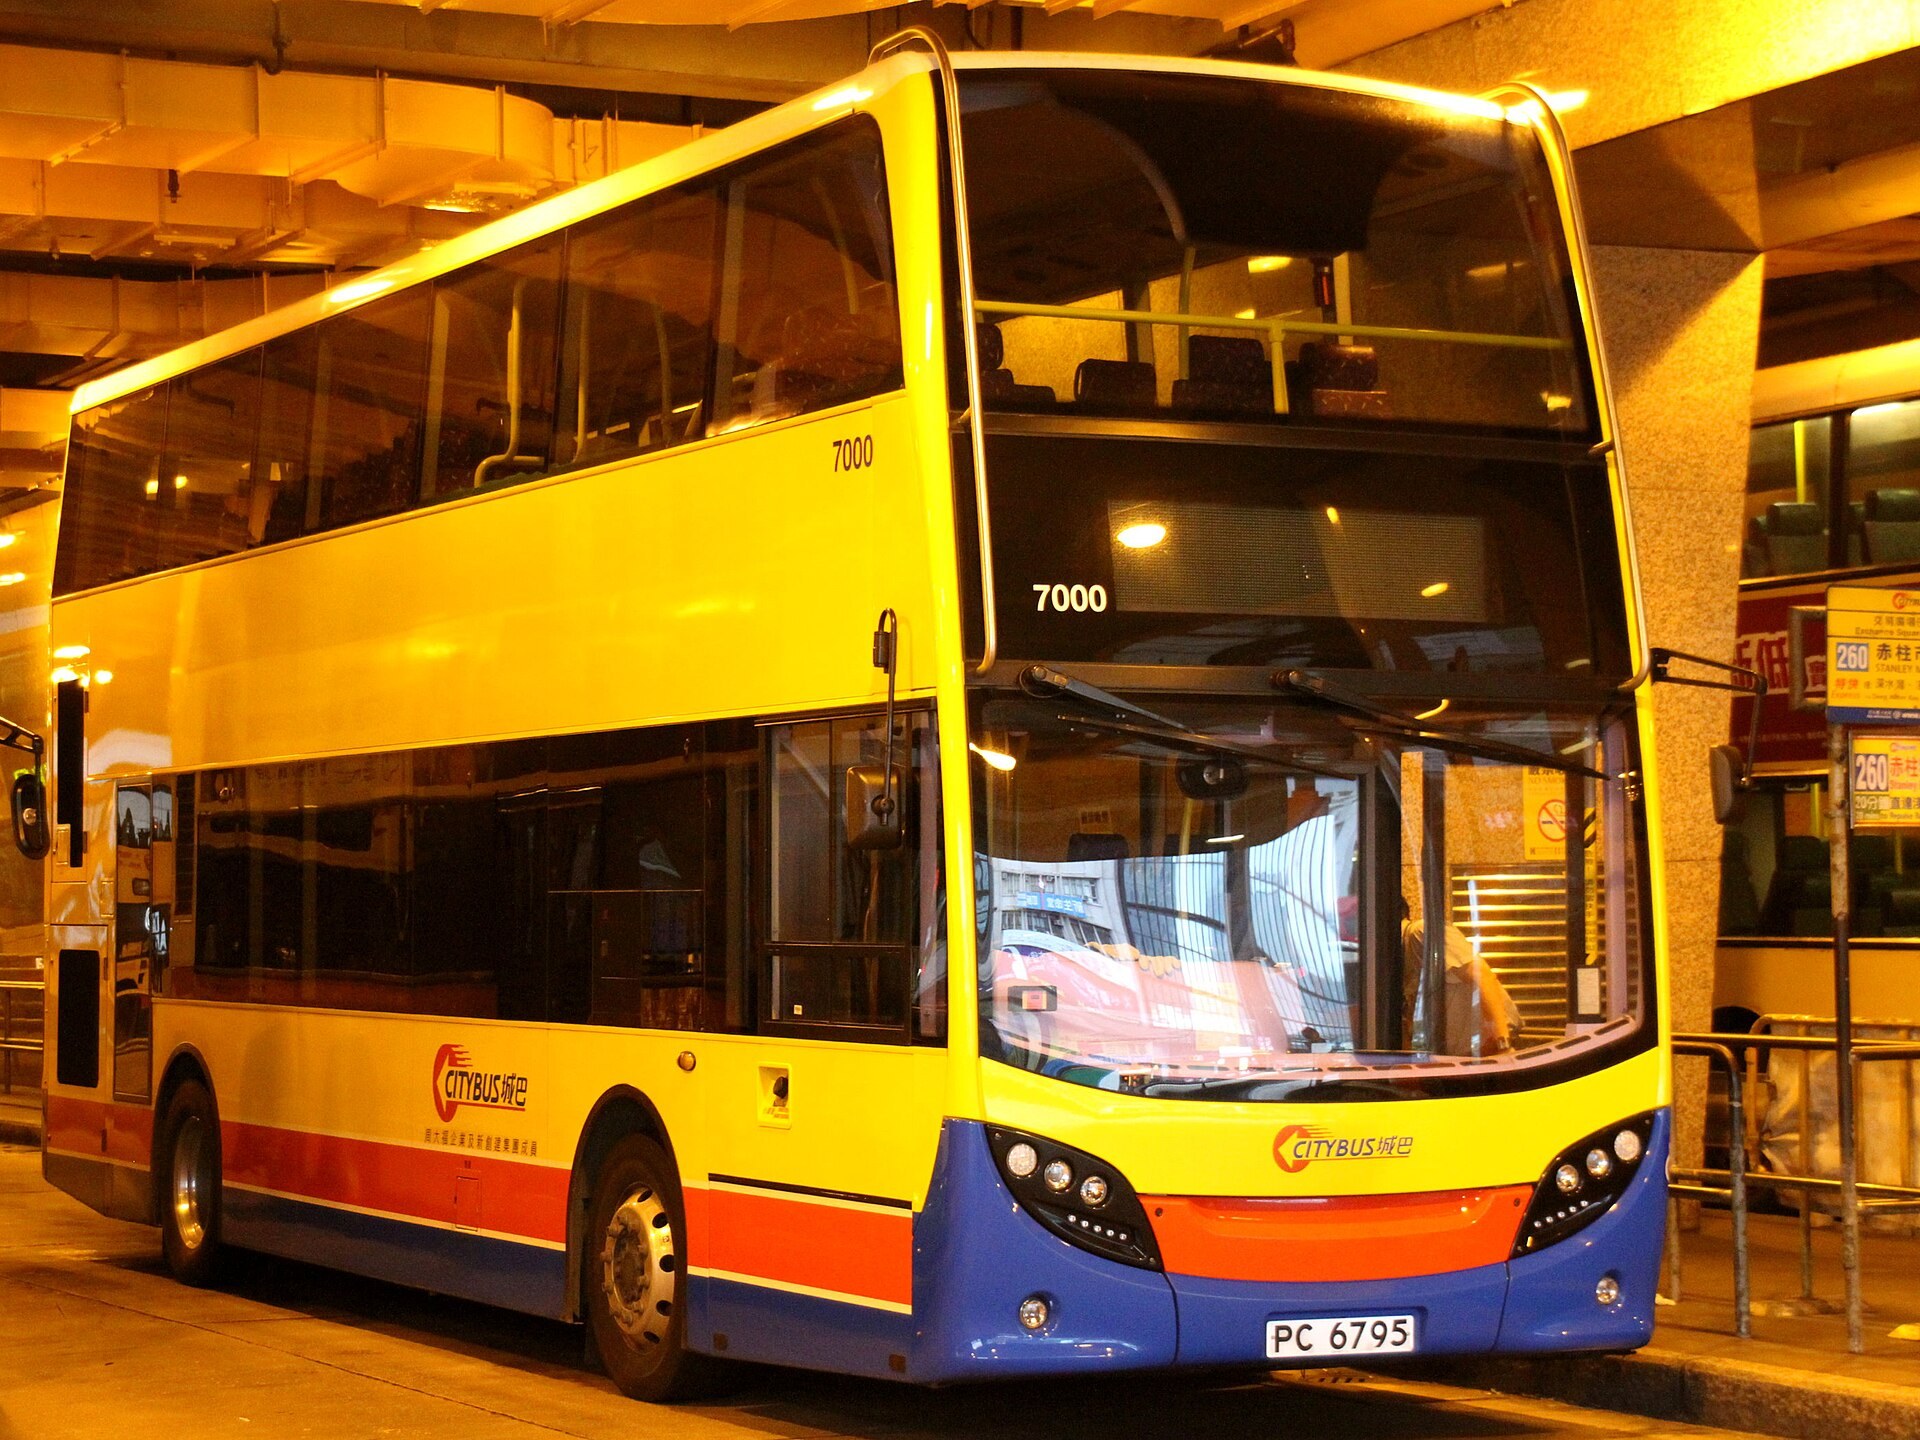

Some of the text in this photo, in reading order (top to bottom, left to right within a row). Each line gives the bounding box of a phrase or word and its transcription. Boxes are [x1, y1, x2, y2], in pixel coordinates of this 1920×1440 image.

[833, 434, 873, 472] 7000
[1032, 583, 1107, 613] 7000
[1897, 628, 1920, 637] Squar
[1836, 643, 1869, 671] 260
[1875, 663, 1913, 674] STANLEY
[1855, 754, 1888, 791] 260
[445, 1069, 528, 1107] CITYBUS 城巴
[1293, 1135, 1414, 1159] CITYBUS 城巴
[1274, 1318, 1408, 1353] PC 6795
